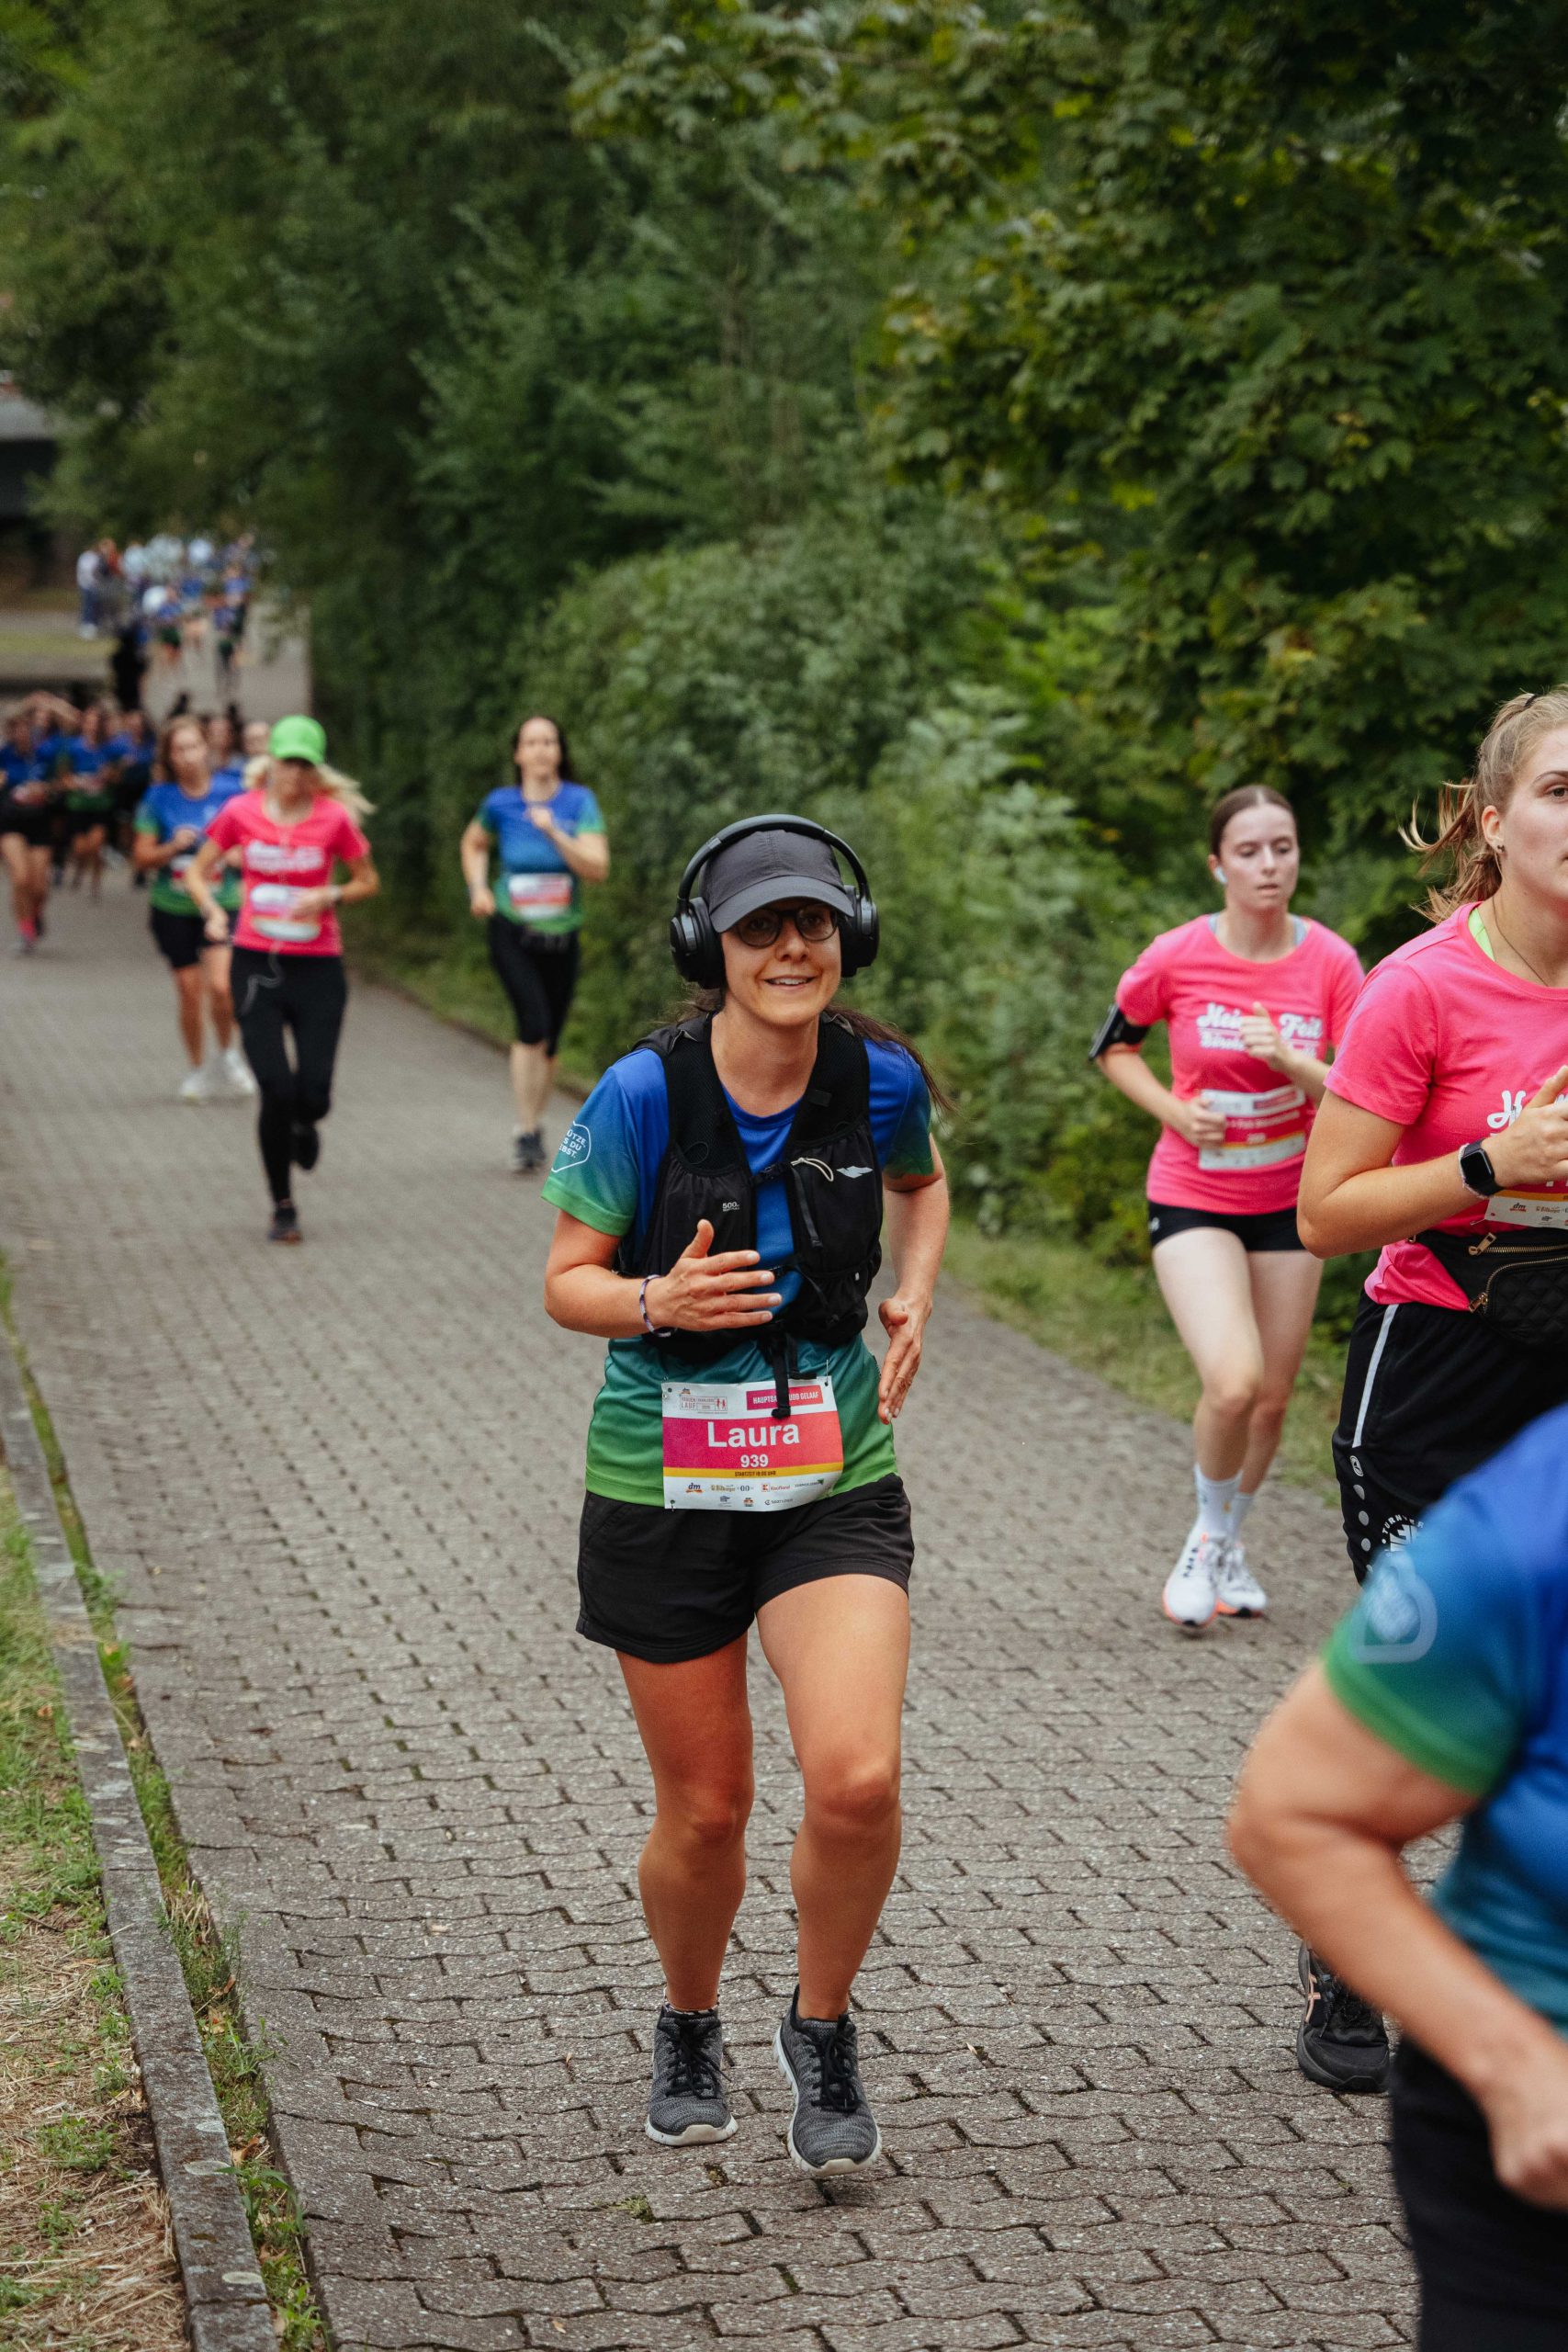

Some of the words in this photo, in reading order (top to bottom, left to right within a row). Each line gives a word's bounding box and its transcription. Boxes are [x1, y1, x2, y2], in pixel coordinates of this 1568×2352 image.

[566, 1129, 586, 1148] ÜTZE,
[570, 1141, 581, 1151] DU
[558, 1144, 577, 1159] EBST.
[752, 1395, 778, 1405] HAUPTSA
[789, 1393, 800, 1401] UDD
[707, 1421, 800, 1448] Laura
[740, 1453, 769, 1468] 939
[688, 1482, 701, 1490] dm
